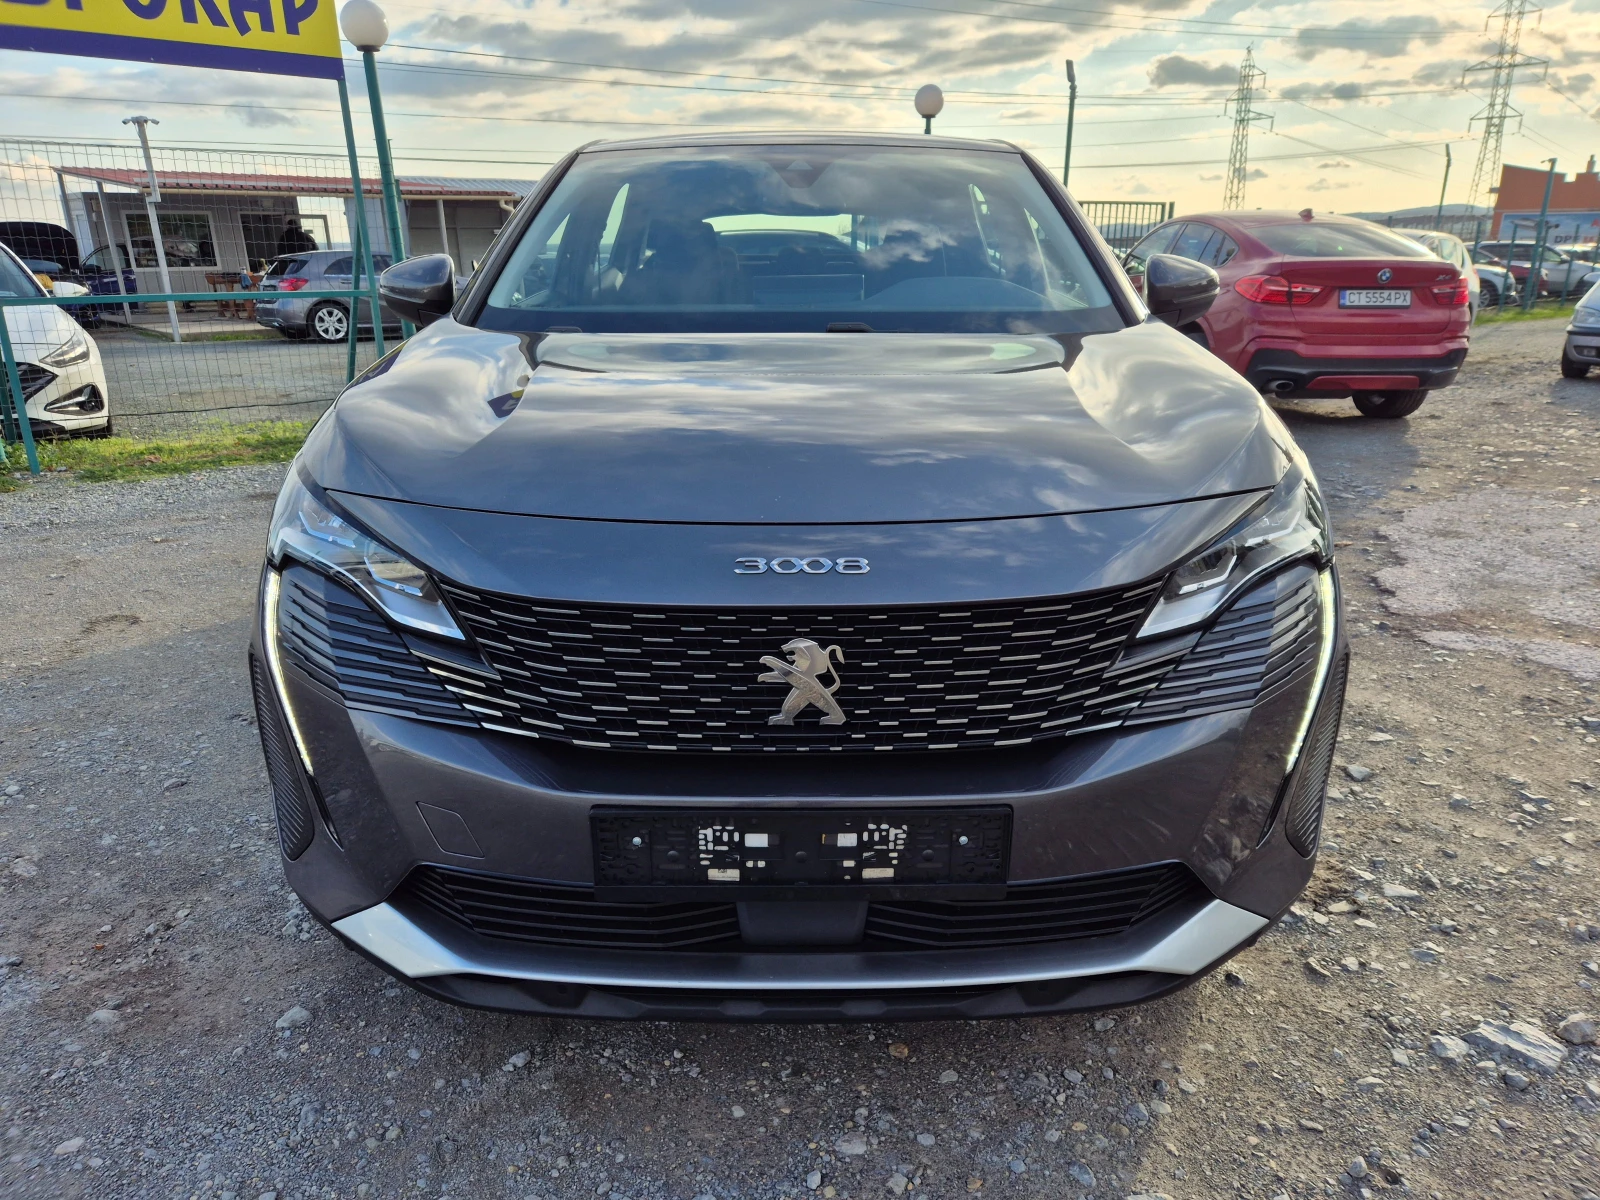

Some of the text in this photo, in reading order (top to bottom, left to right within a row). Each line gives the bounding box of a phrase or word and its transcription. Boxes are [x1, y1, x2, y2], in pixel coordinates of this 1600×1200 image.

[1348, 291, 1408, 304] CT 5554 PX
[733, 557, 871, 575] 3008
